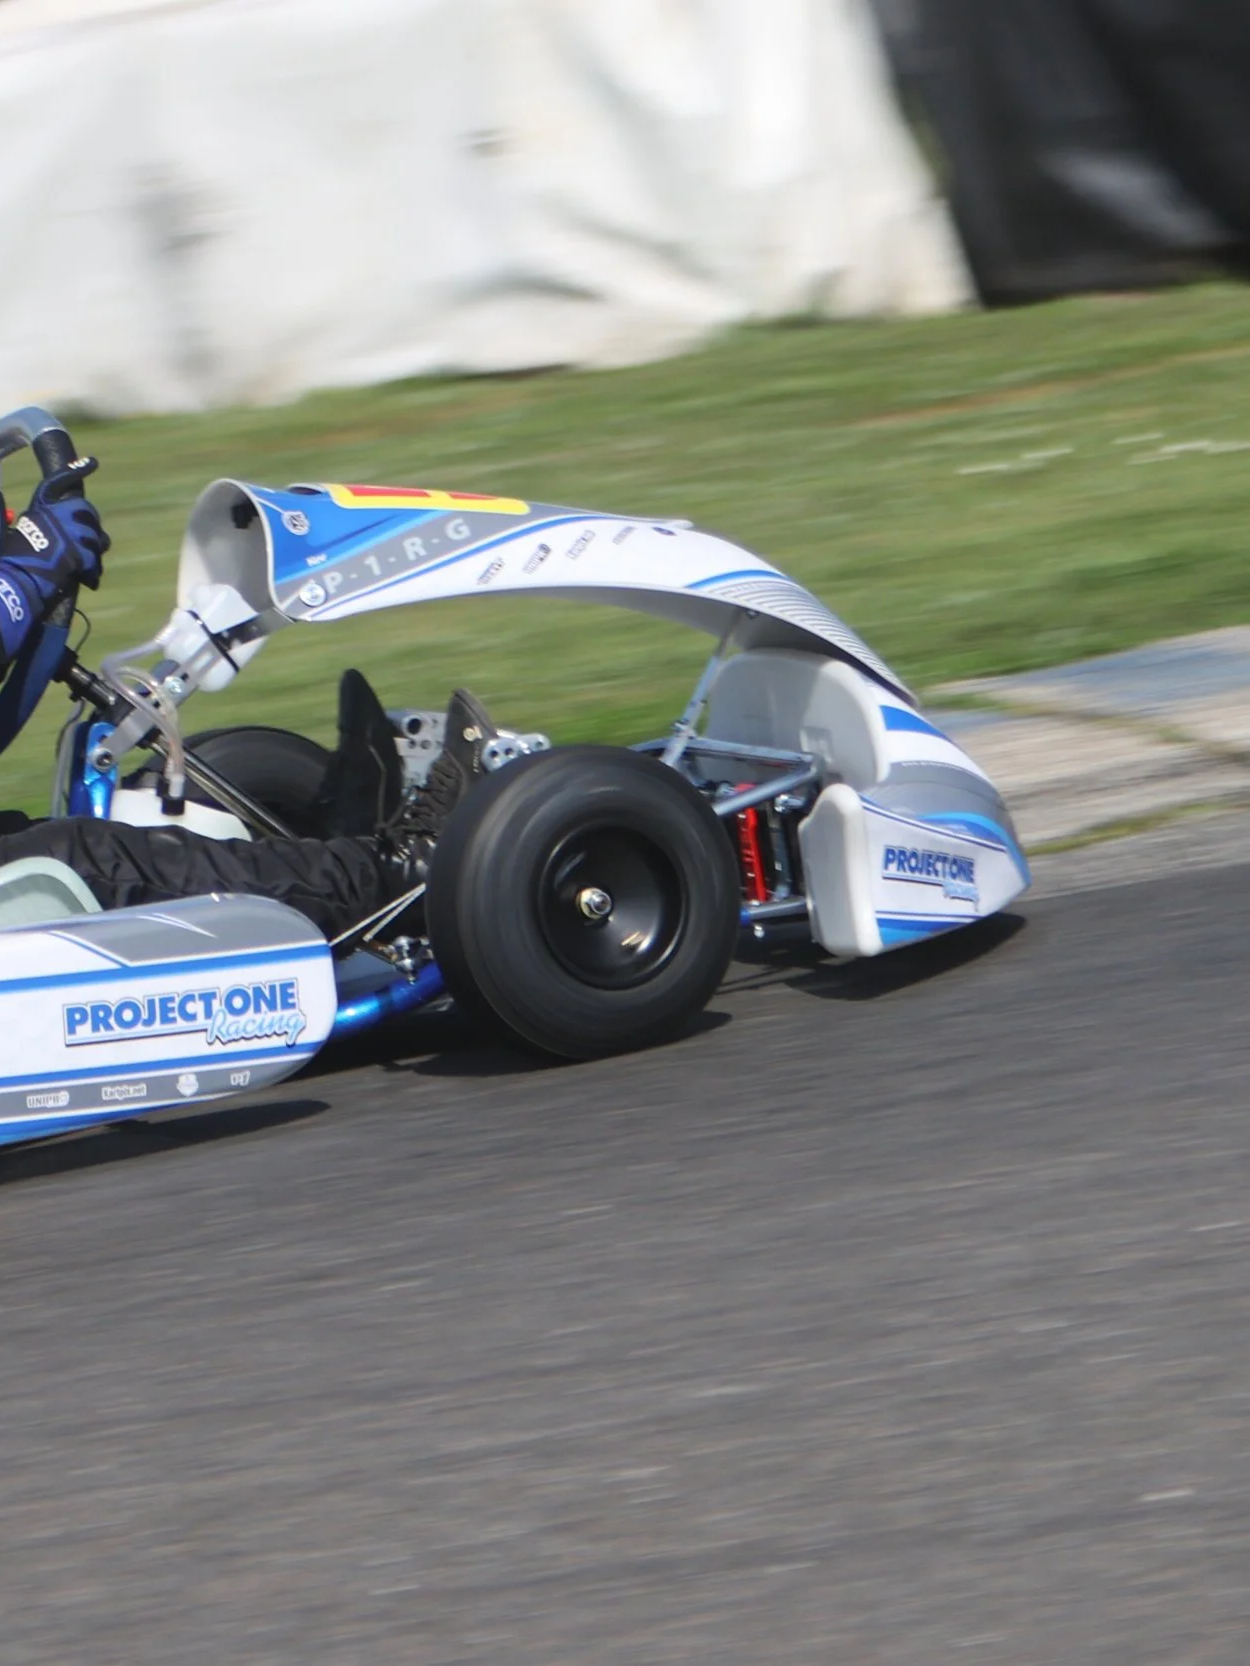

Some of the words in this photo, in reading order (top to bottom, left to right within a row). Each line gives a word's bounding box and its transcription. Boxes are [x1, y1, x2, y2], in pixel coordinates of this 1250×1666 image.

[883, 847, 949, 880] PROJECT
[949, 857, 975, 884] ONE
[65, 990, 218, 1036] PROJECT
[224, 981, 298, 1016] ONE
[206, 1008, 306, 1047] Racing
